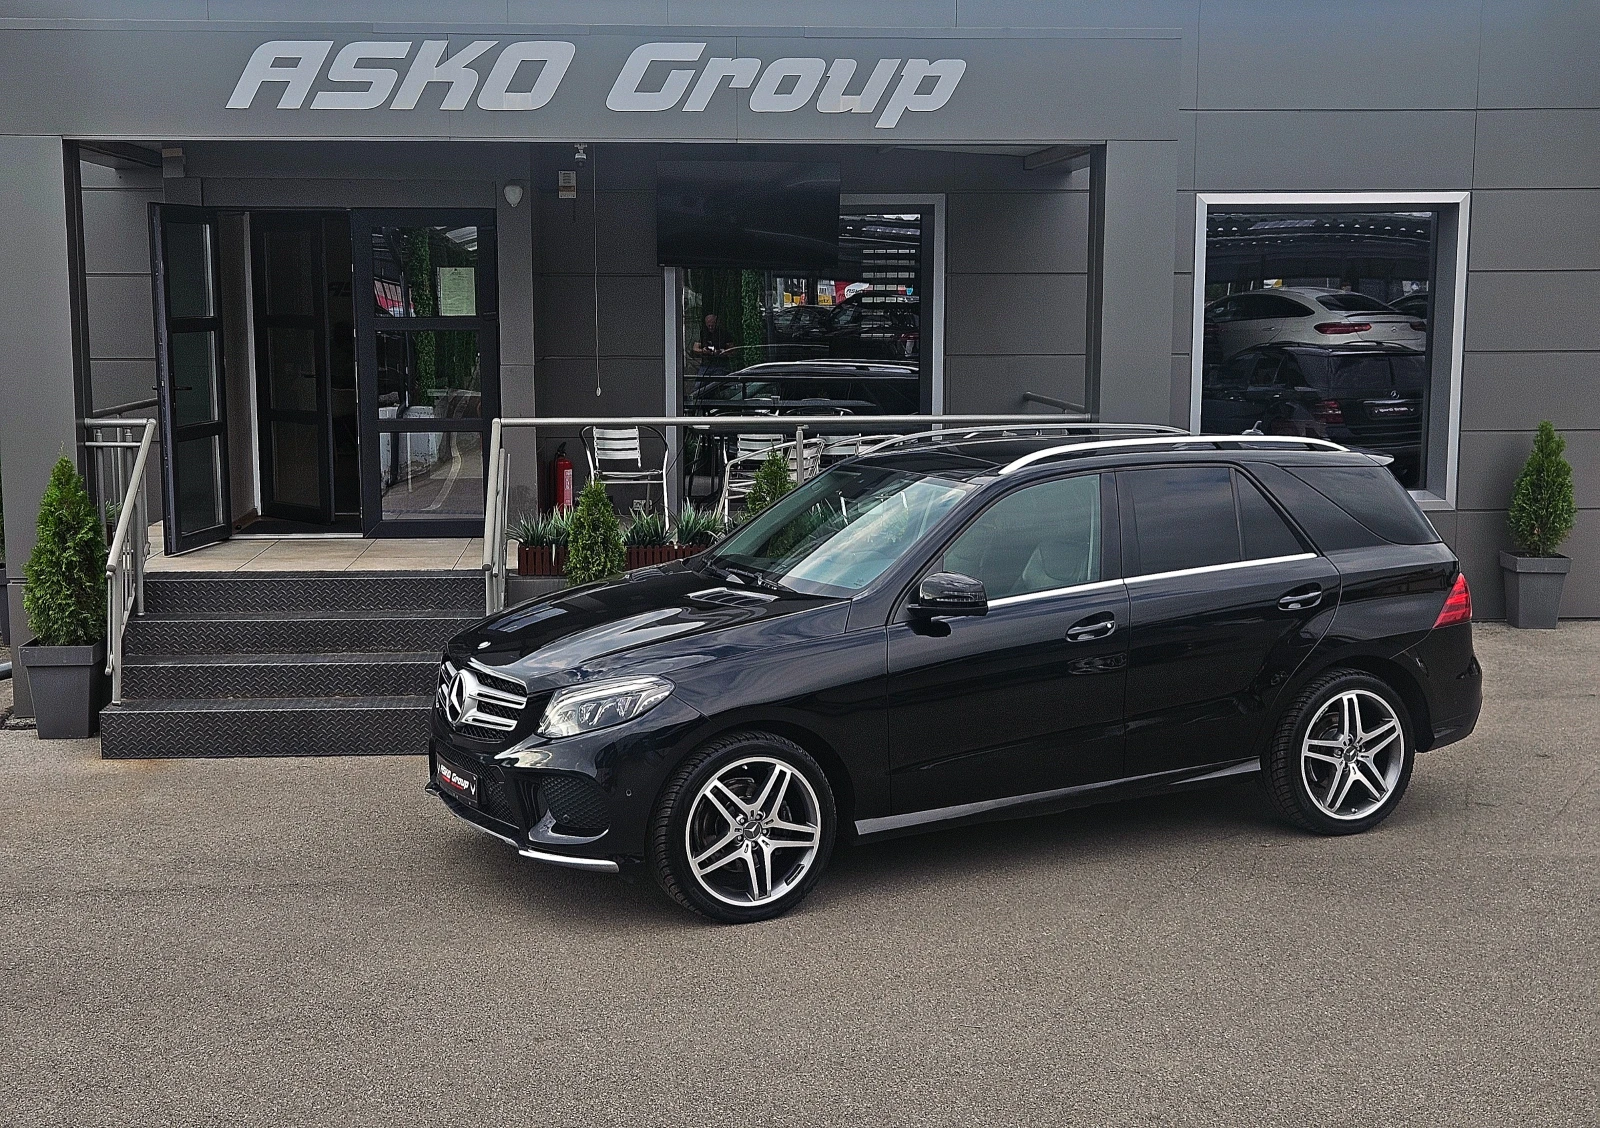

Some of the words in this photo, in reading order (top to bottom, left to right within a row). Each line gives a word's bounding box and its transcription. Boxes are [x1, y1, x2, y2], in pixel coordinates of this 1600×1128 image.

[225, 40, 576, 111] ASKO
[605, 42, 967, 129] Group
[451, 772, 469, 789] Group
